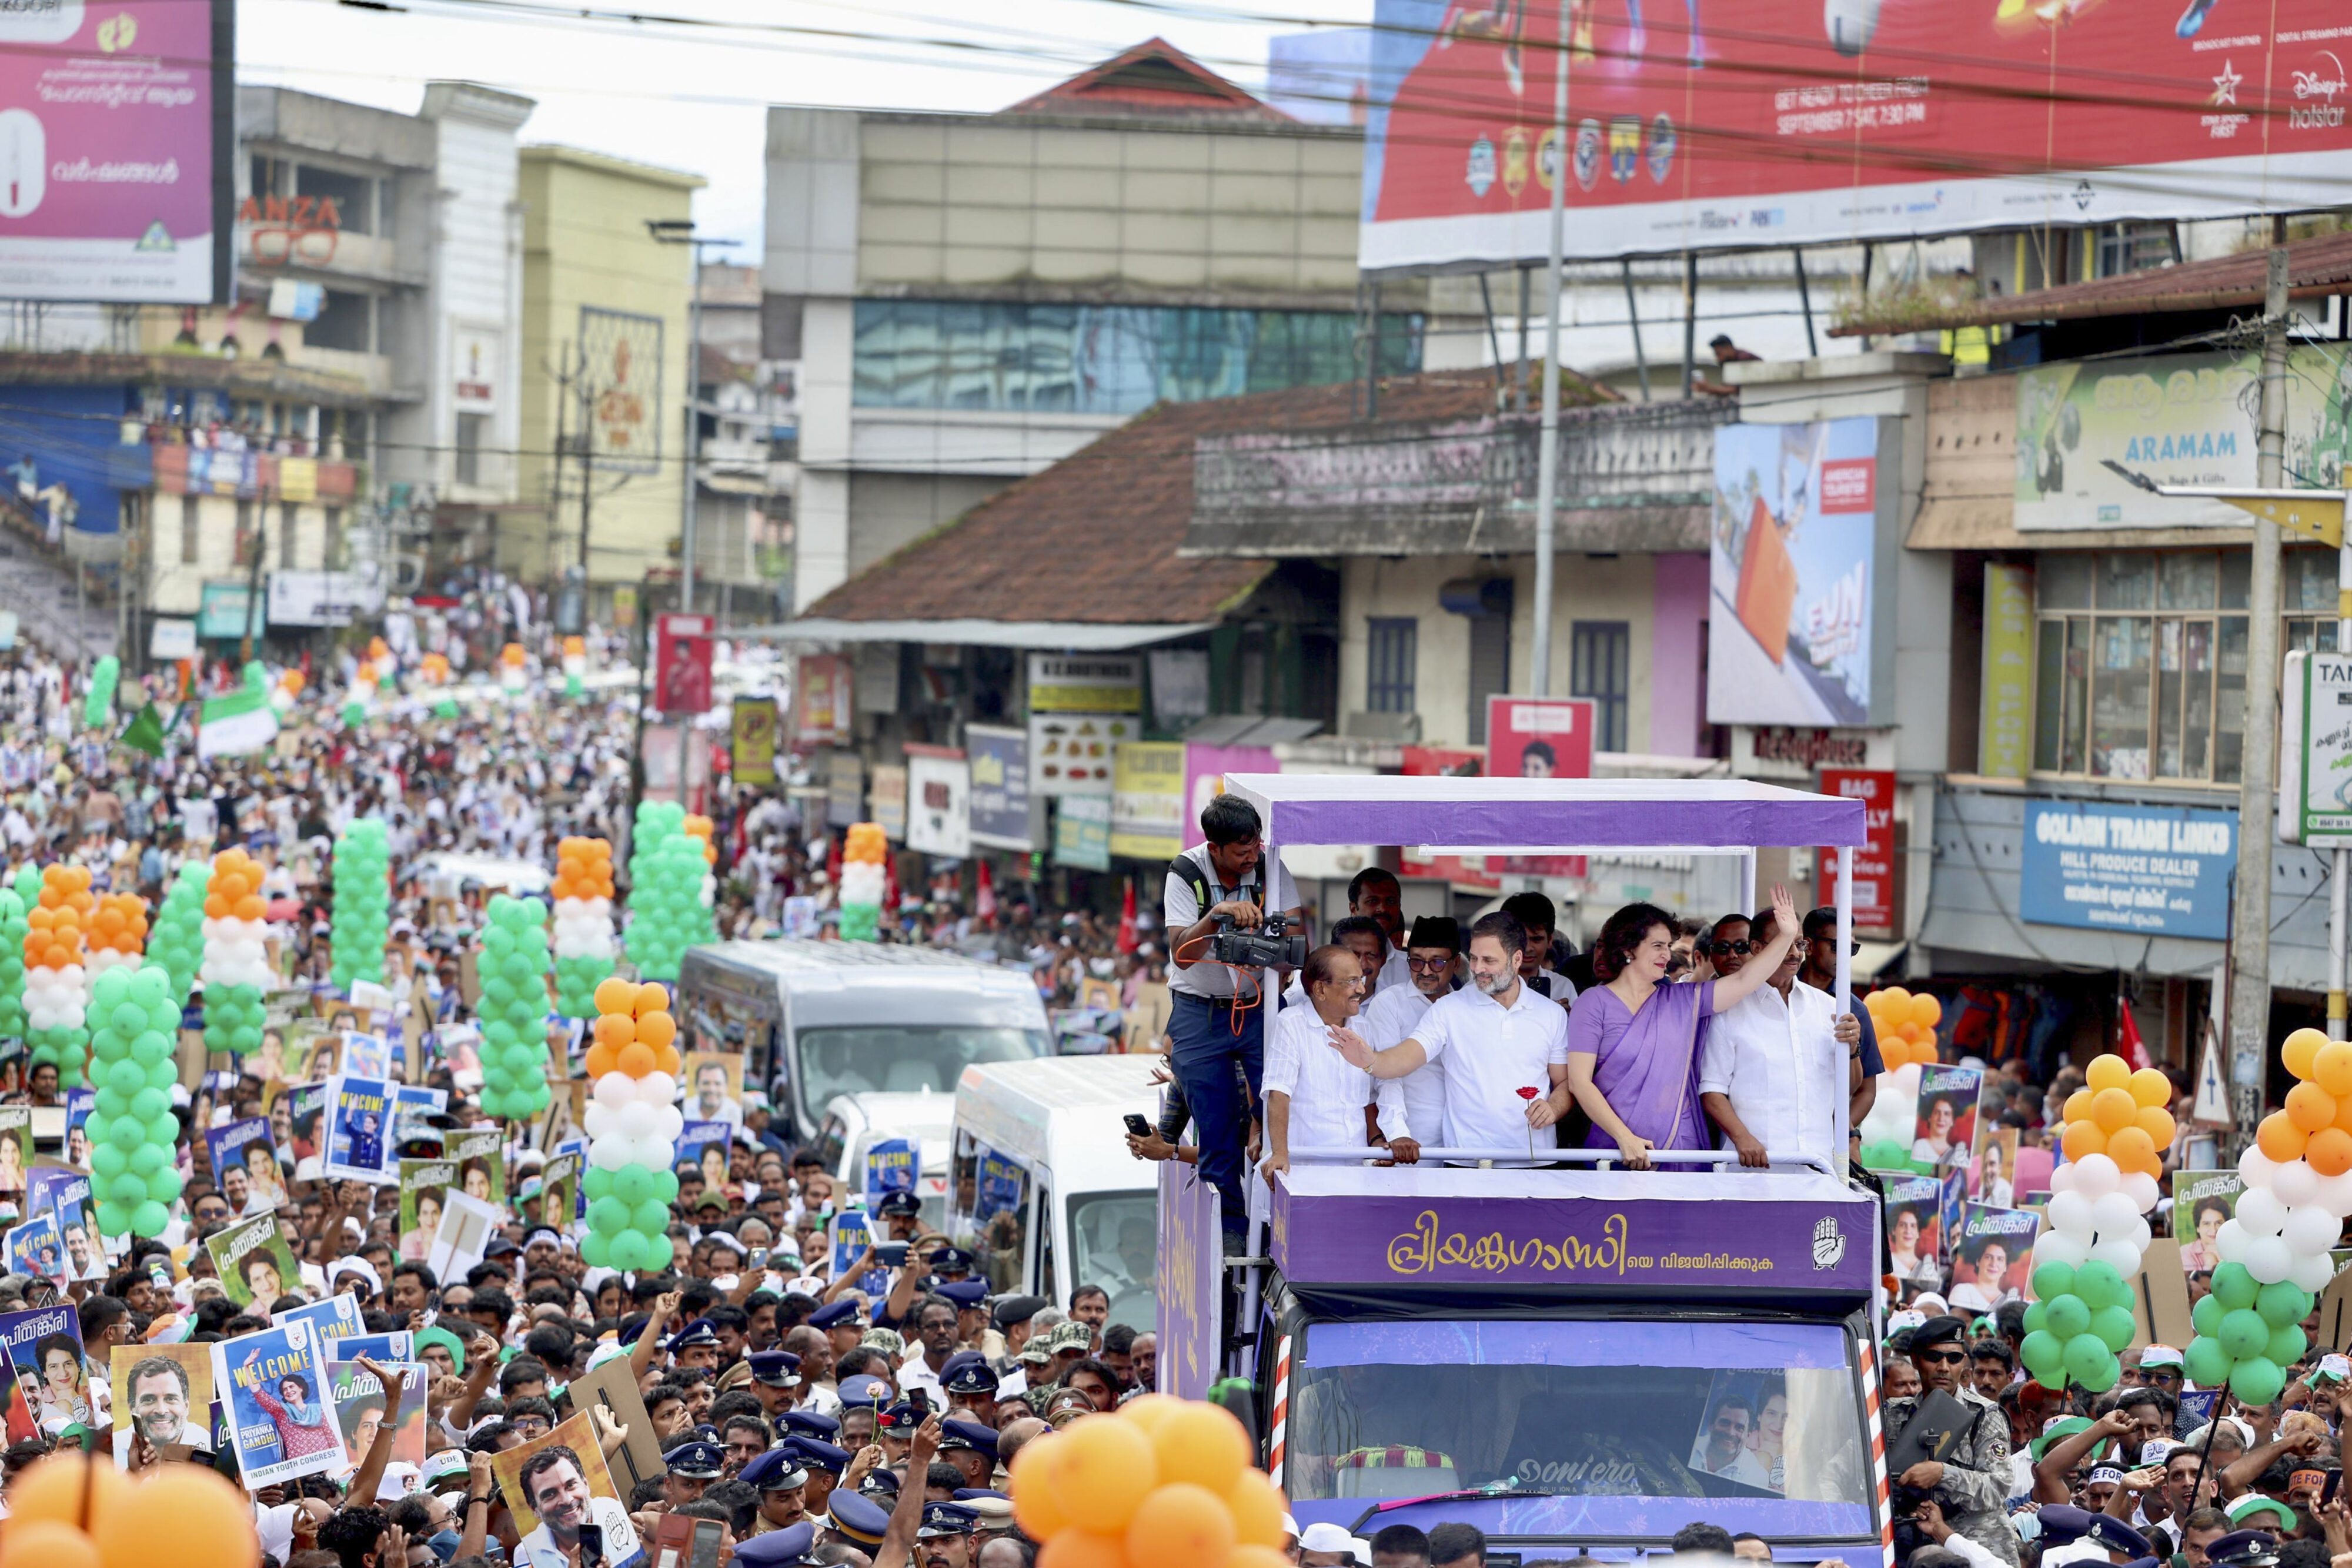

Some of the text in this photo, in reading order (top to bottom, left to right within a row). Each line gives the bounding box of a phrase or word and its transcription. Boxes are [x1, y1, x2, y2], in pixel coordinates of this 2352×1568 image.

[2290, 104, 2346, 129] hotstar
[2126, 432, 2237, 462] ARAMAM
[1839, 778, 1876, 797] BAG
[2036, 811, 2230, 855] GOLDEN TRADE LINKS
[2060, 850, 2200, 877] HILL PRODUCE DEALER
[1920, 1074, 1976, 1095] പ്രിയങ്കരി
[2179, 1176, 2241, 1205] പ്രിയങ്കരി
[1965, 1215, 2033, 1236] പ്രിയങ്കരി
[220, 1217, 276, 1271] പ്രിയങ്കരി
[1661, 1253, 1773, 1273] വിജയിപ്പിക്കുക
[233, 1349, 312, 1388] WELCOME
[240, 1423, 274, 1440] PRIYANKA
[243, 1436, 277, 1450] GANDHI
[250, 1450, 336, 1480] INDIAN YOUTH CONGRESS
[440, 1455, 458, 1465] UDF
[1517, 1453, 1636, 1486] Soniero
[2102, 1469, 2122, 1482] FOR
[2289, 1474, 2301, 1487] OTE
